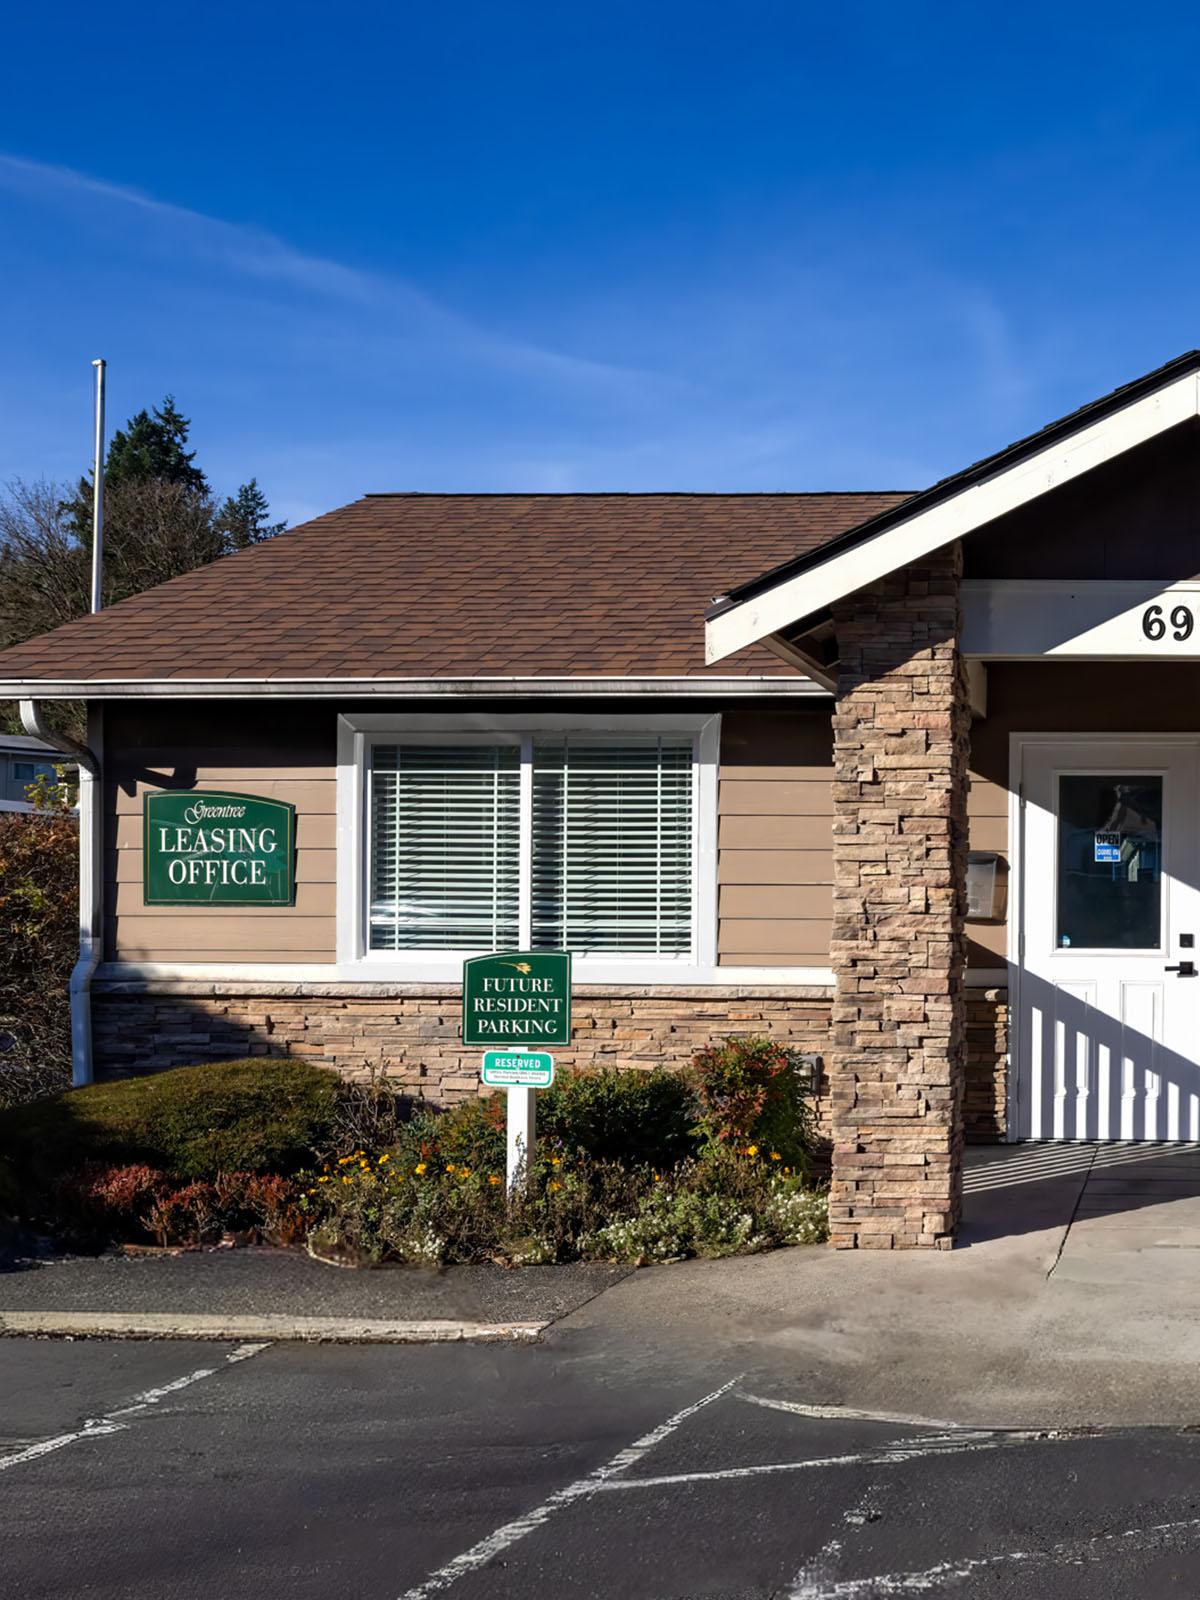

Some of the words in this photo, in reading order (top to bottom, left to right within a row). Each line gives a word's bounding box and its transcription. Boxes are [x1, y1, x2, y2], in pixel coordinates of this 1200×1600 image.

[184, 800, 246, 824] Greentree
[159, 828, 277, 853] LEASING
[168, 859, 267, 885] OFFICE
[483, 978, 554, 993] FUTURE
[473, 998, 563, 1013] RESIDENT
[476, 1019, 558, 1034] PARKING
[494, 1058, 541, 1068] RESERVED
